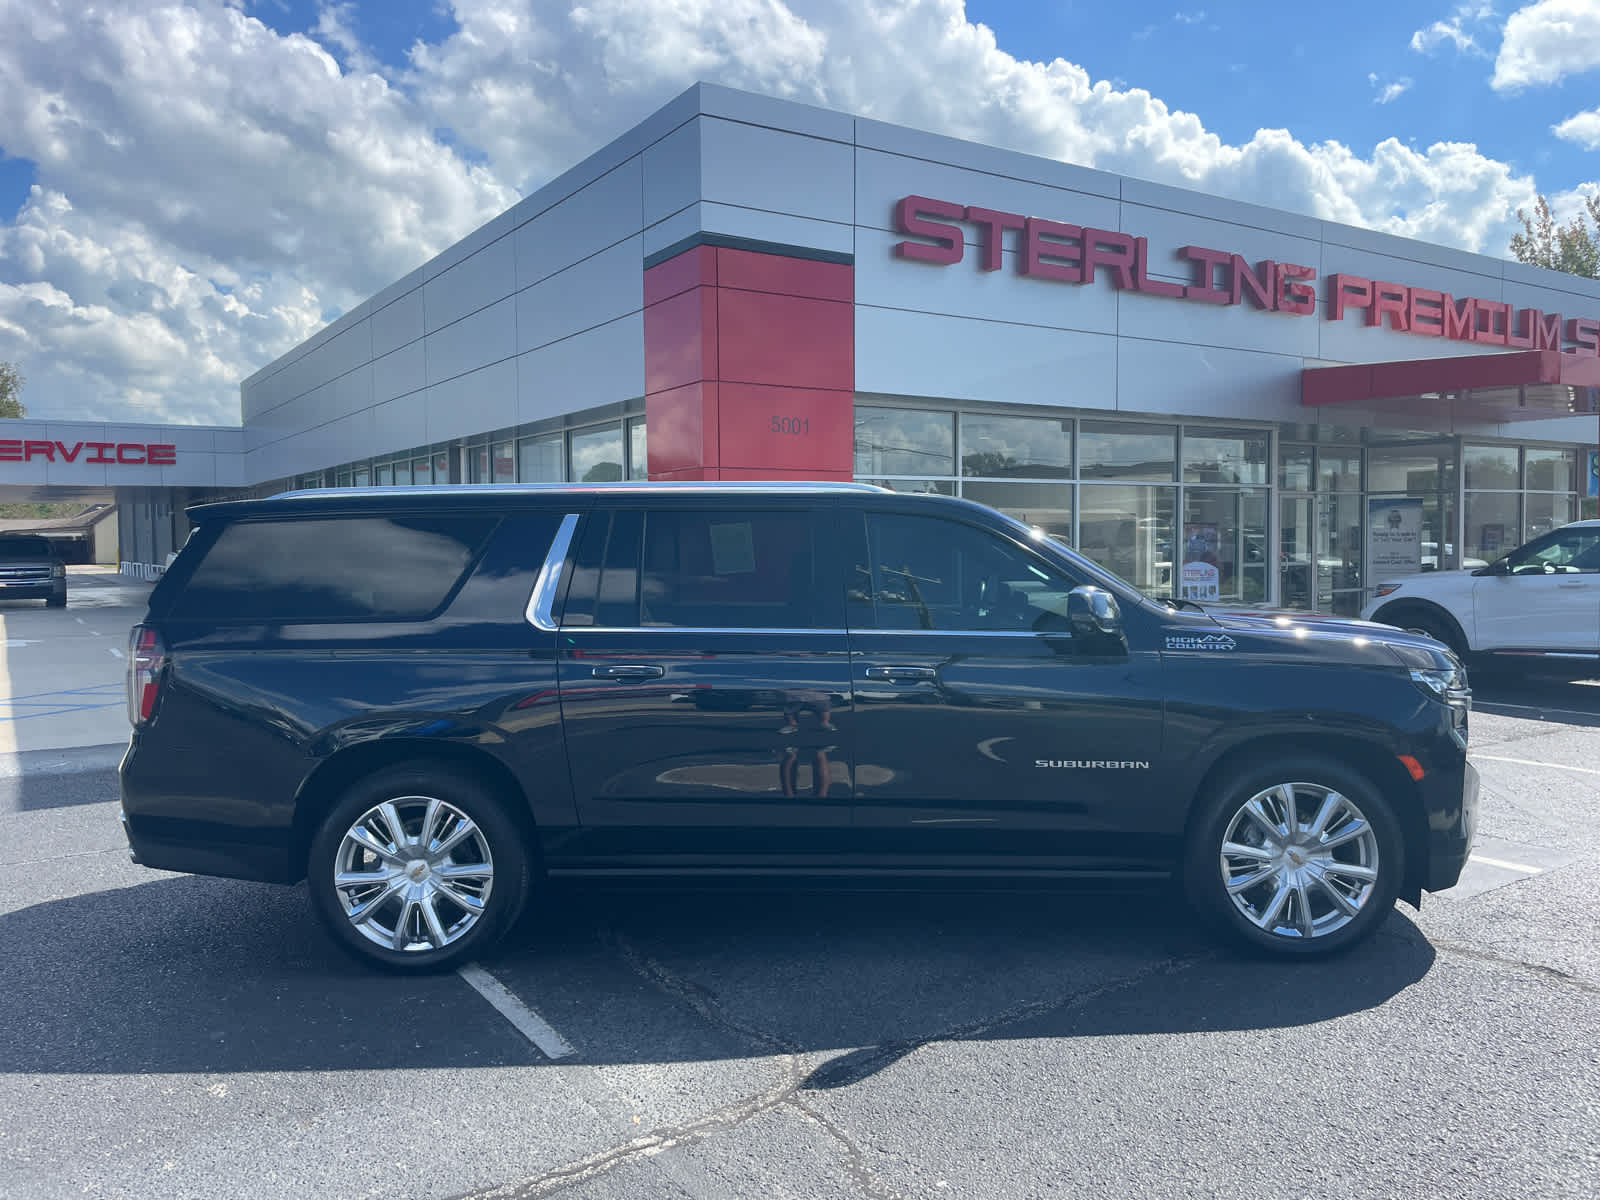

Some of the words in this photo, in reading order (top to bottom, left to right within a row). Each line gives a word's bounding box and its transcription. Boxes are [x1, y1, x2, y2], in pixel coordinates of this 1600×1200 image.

[896, 194, 1316, 316] STERLING
[1327, 272, 1563, 353] PREMIUM
[1566, 317, 1600, 359] S
[770, 415, 809, 436] 5001
[1034, 760, 1150, 769] SUBURBAN
